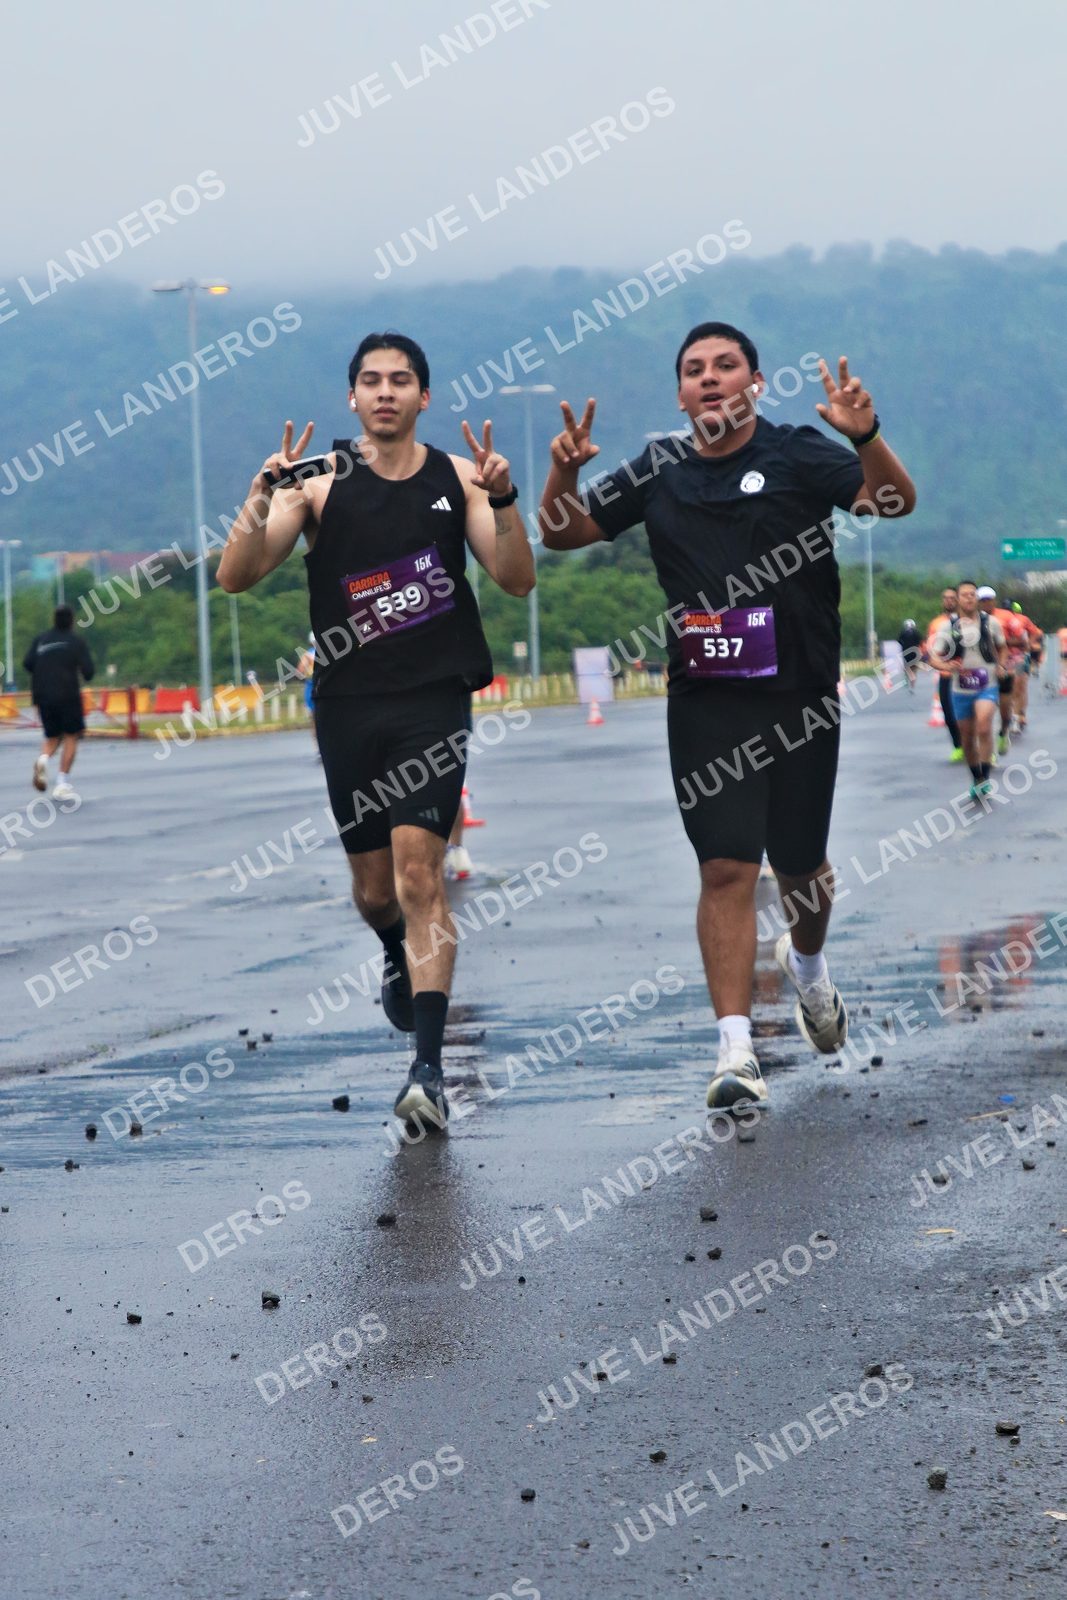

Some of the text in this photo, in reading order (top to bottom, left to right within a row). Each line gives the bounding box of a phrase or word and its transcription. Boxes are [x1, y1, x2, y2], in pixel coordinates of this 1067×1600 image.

[414, 554, 432, 572] 15K
[349, 571, 390, 593] CARRERA
[352, 586, 383, 600] OMNILIFE
[376, 586, 422, 616] 539
[685, 615, 722, 626] CARRERA
[747, 612, 766, 627] 15K
[686, 625, 714, 633] OMNILIFE
[703, 637, 744, 657] 537
